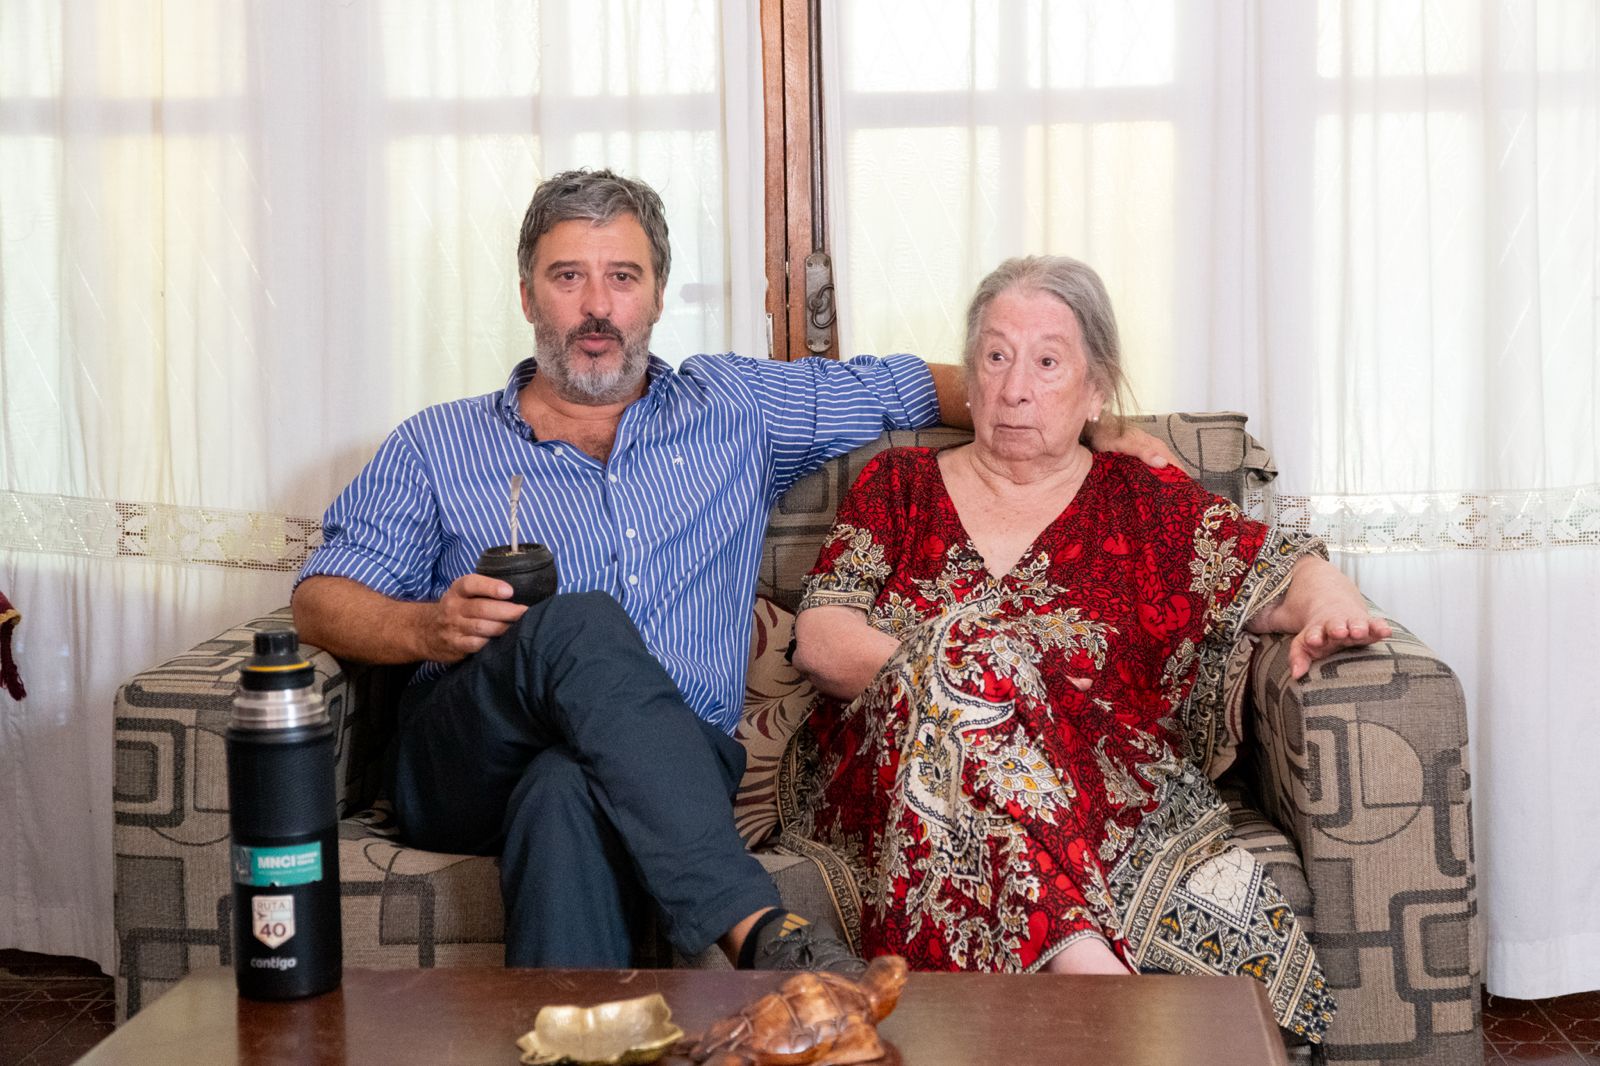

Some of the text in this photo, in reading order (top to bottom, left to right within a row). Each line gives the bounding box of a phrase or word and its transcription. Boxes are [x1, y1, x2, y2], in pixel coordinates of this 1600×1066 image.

[257, 855, 296, 869] MNCI
[257, 902, 286, 911] RUTA
[260, 923, 286, 938] 40
[250, 957, 297, 971] contigo
